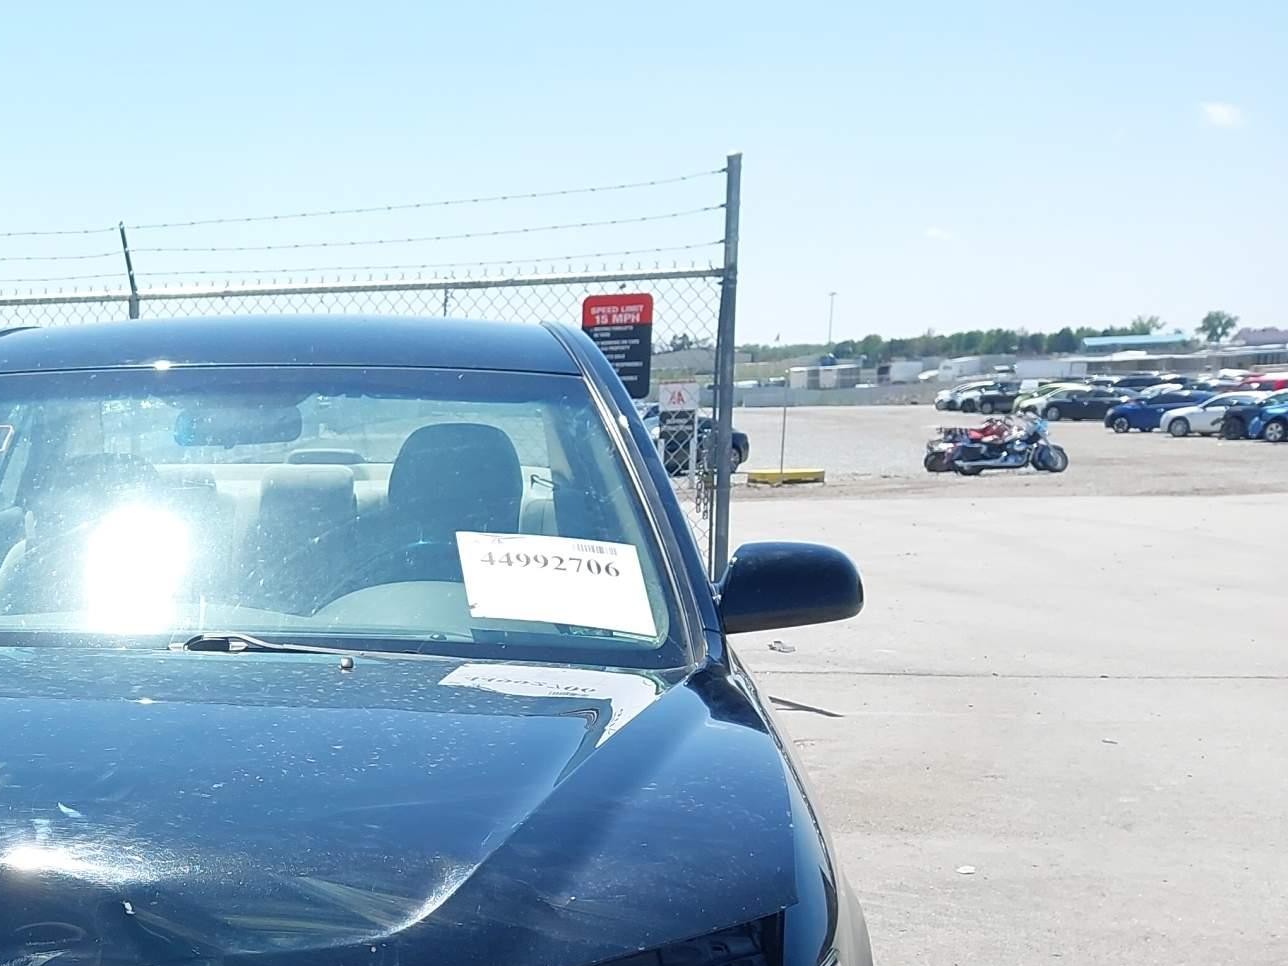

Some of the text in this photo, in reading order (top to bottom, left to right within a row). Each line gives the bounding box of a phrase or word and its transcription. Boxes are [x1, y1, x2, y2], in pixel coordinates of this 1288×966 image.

[594, 312, 641, 325] 15 MPH
[480, 550, 621, 577] 44992706
